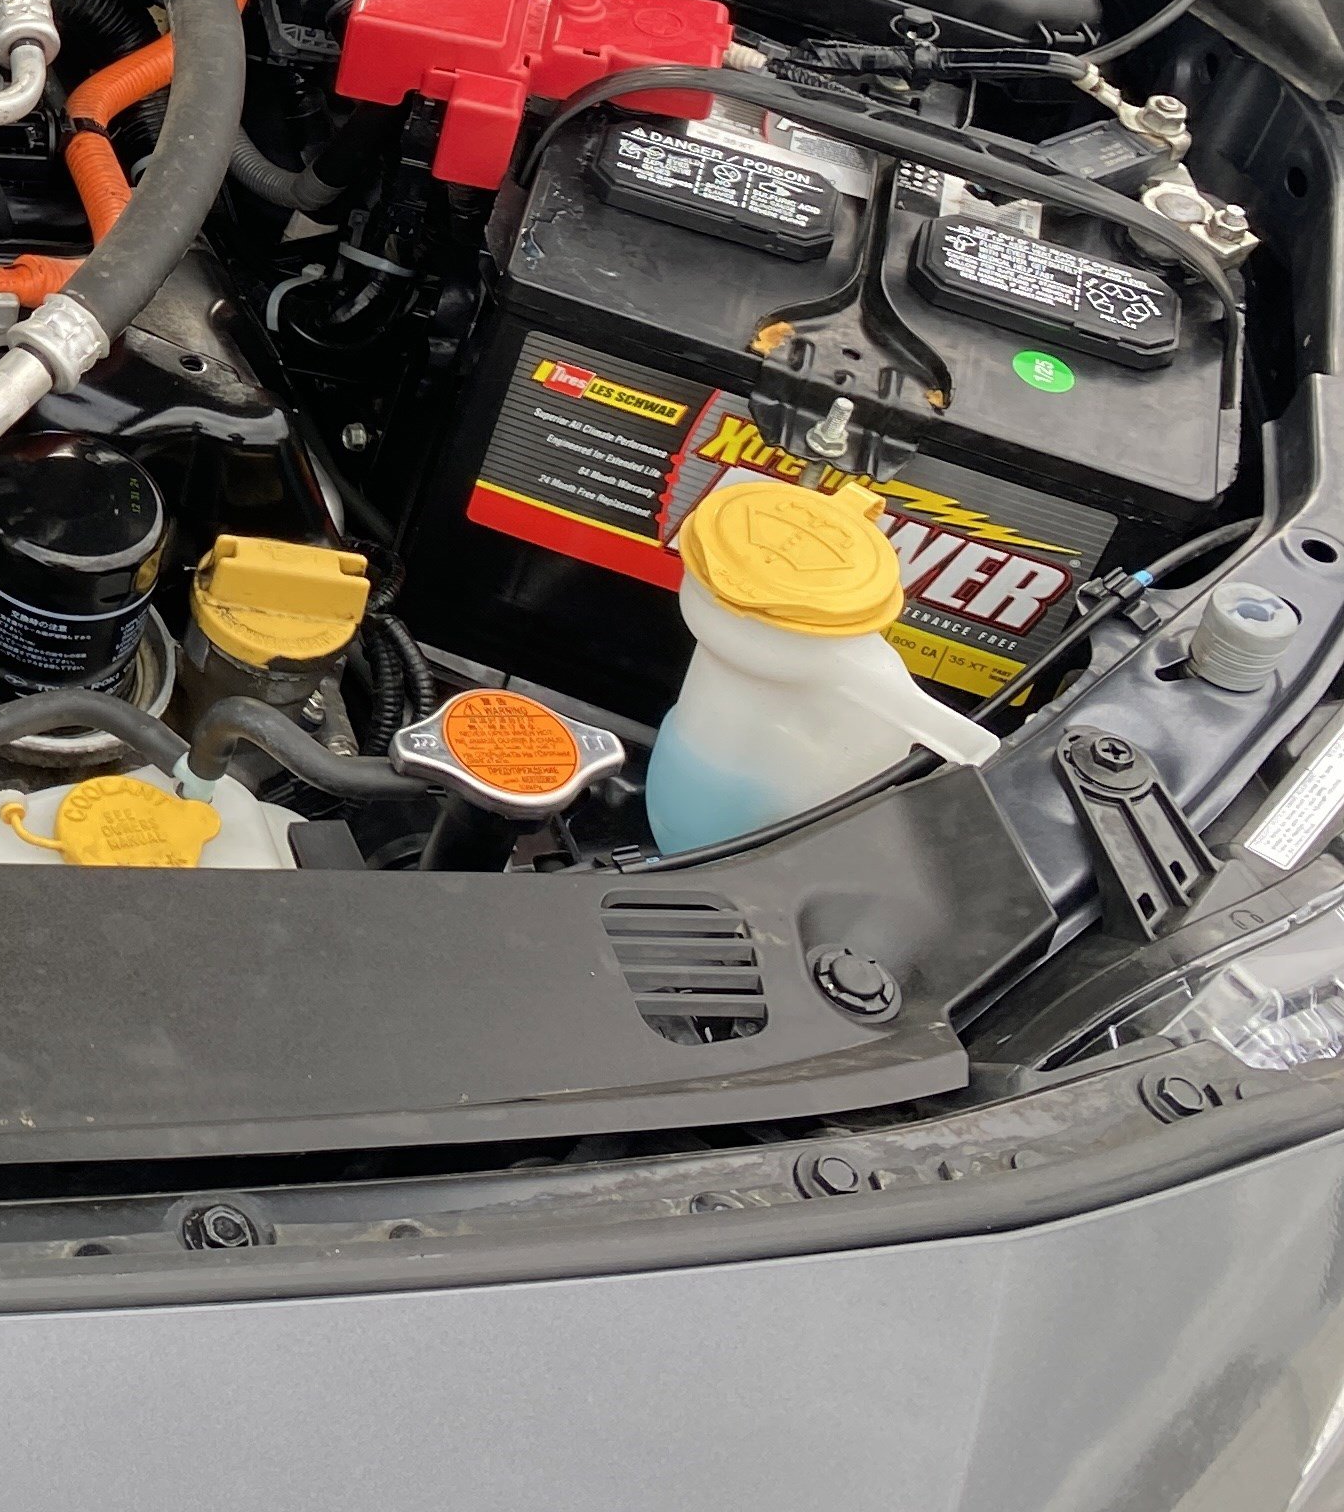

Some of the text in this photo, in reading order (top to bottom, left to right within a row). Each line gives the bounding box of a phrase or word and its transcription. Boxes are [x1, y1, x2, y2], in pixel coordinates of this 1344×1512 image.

[650, 132, 724, 160] DANGER
[743, 159, 811, 185] POISON
[550, 365, 588, 389] Tires
[589, 382, 679, 419] LES SCHWAB
[533, 407, 570, 428] Superior
[582, 423, 615, 442] Climate
[614, 434, 668, 459] Performance
[546, 433, 593, 458] Engineered
[605, 453, 644, 474] Extended
[644, 464, 662, 479] Life
[549, 477, 577, 494] Month
[576, 486, 597, 501] Free
[596, 492, 653, 519] Replacement
[590, 469, 616, 486] Month
[617, 476, 656, 499] Warranty
[920, 645, 939, 660] CA
[978, 630, 1018, 652] FREE
[948, 654, 989, 673] 35 XT
[64, 780, 174, 822] COOLANT
